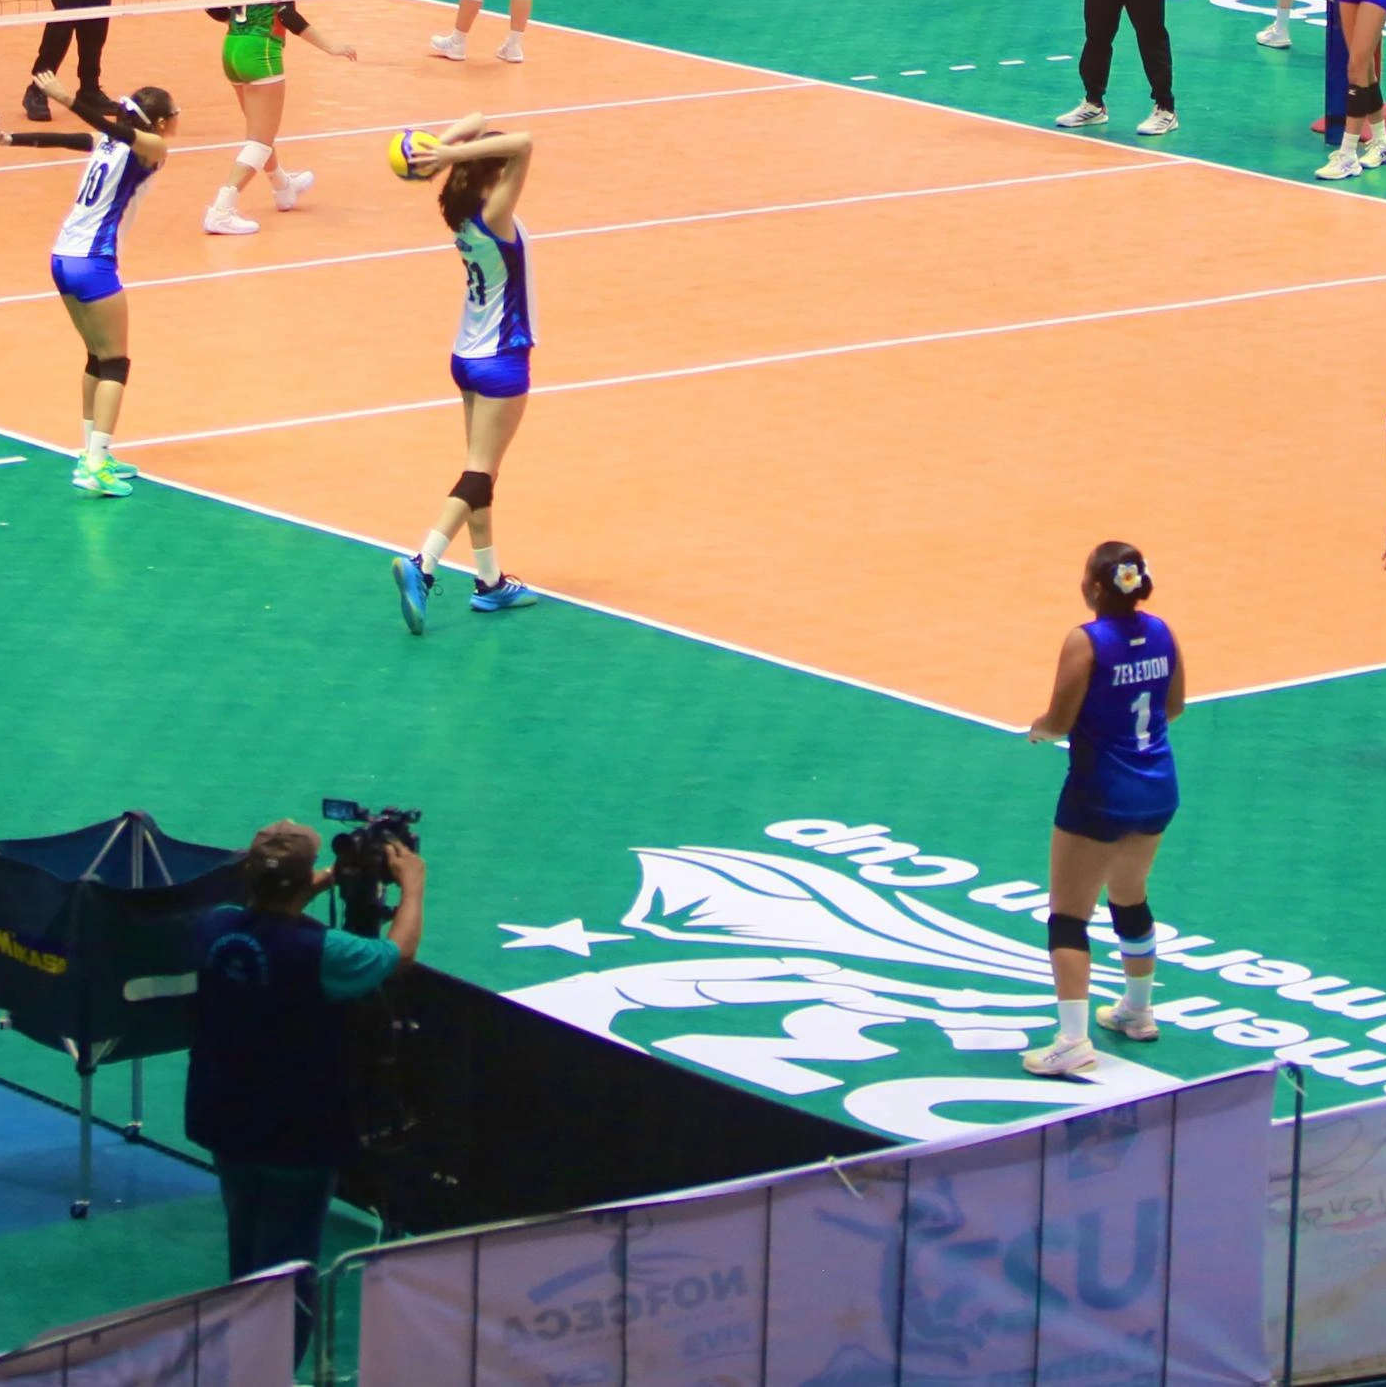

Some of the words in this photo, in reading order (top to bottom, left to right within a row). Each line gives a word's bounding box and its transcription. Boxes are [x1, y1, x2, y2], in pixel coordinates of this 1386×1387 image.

[1112, 656, 1169, 686] ZELEDON
[1131, 691, 1152, 751] 1
[764, 818, 979, 888] Cup
